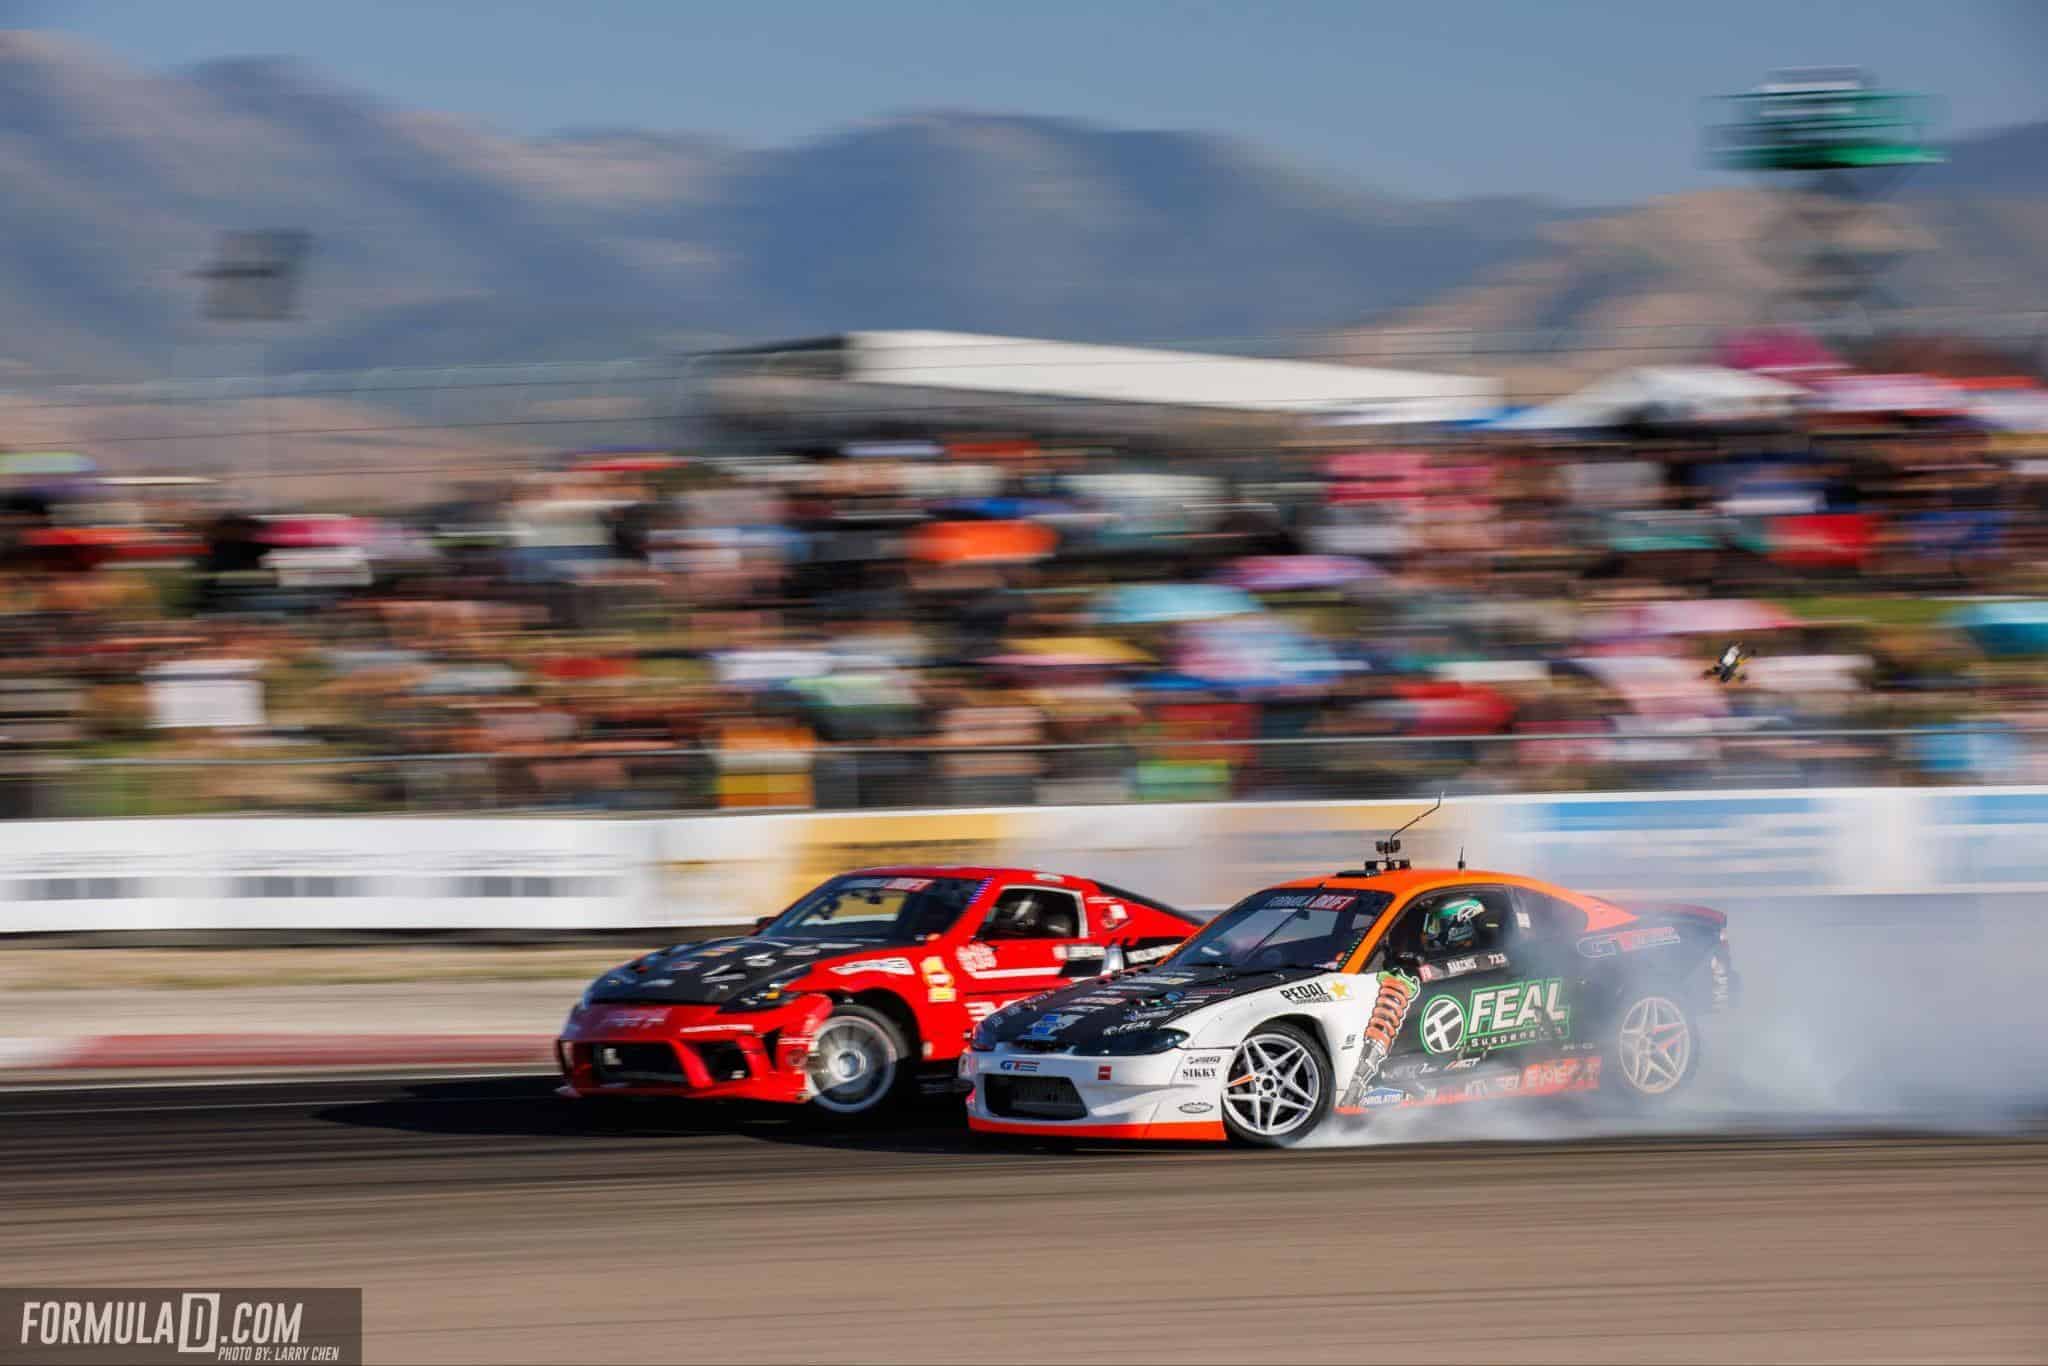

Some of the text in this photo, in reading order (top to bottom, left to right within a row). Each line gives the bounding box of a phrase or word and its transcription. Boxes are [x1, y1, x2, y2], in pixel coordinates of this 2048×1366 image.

[1280, 982, 1329, 1001] PEDAL
[1469, 983, 1566, 1034] FEAL
[1471, 1026, 1562, 1048] Suspens
[1182, 1068, 1216, 1078] SIKKY
